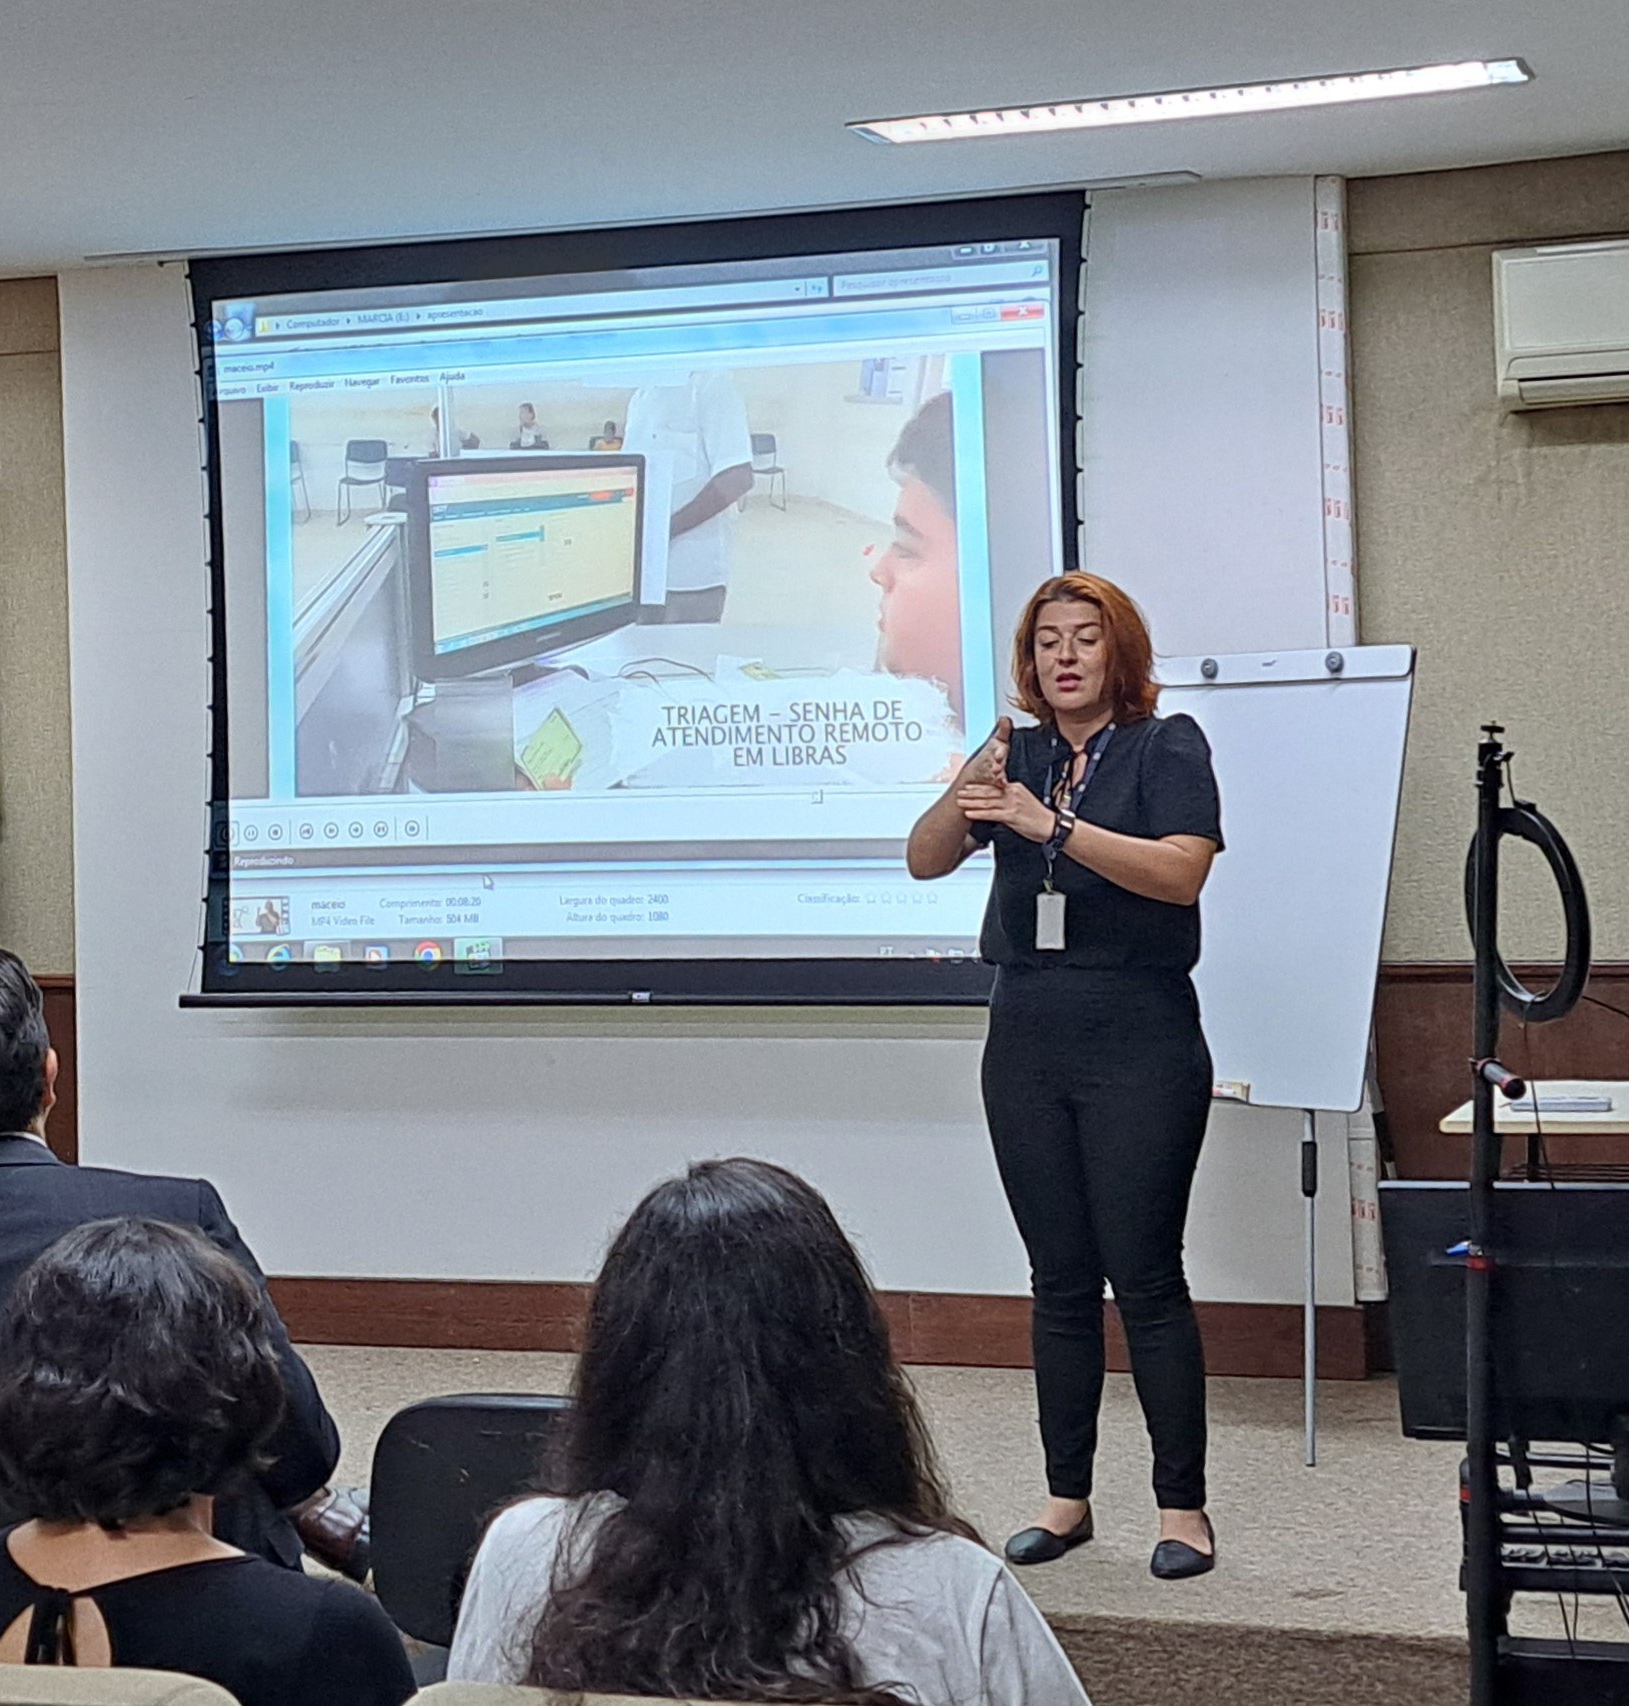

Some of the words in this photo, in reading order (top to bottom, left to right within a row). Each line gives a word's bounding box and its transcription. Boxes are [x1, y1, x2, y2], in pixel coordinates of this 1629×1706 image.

[286, 318, 340, 331] Computador
[427, 308, 484, 322] apresentacao
[345, 377, 380, 389] Navegar
[390, 374, 429, 385] Favoritos
[440, 371, 466, 383] Ajuda
[660, 704, 761, 726] TRIAGEM
[789, 701, 865, 723] SENHA
[873, 700, 903, 721] DE
[651, 724, 815, 747] ATENDIMENTO
[824, 721, 923, 744] REMOTO
[733, 747, 764, 767] EM
[772, 745, 848, 766] LIBRAS
[233, 855, 294, 868] Reproduzindo
[379, 898, 442, 910] Comprimento:
[559, 896, 593, 907] Largura
[595, 895, 607, 905] do
[648, 894, 669, 904] 2400
[398, 914, 443, 925] Tamanho:
[595, 912, 607, 921] do
